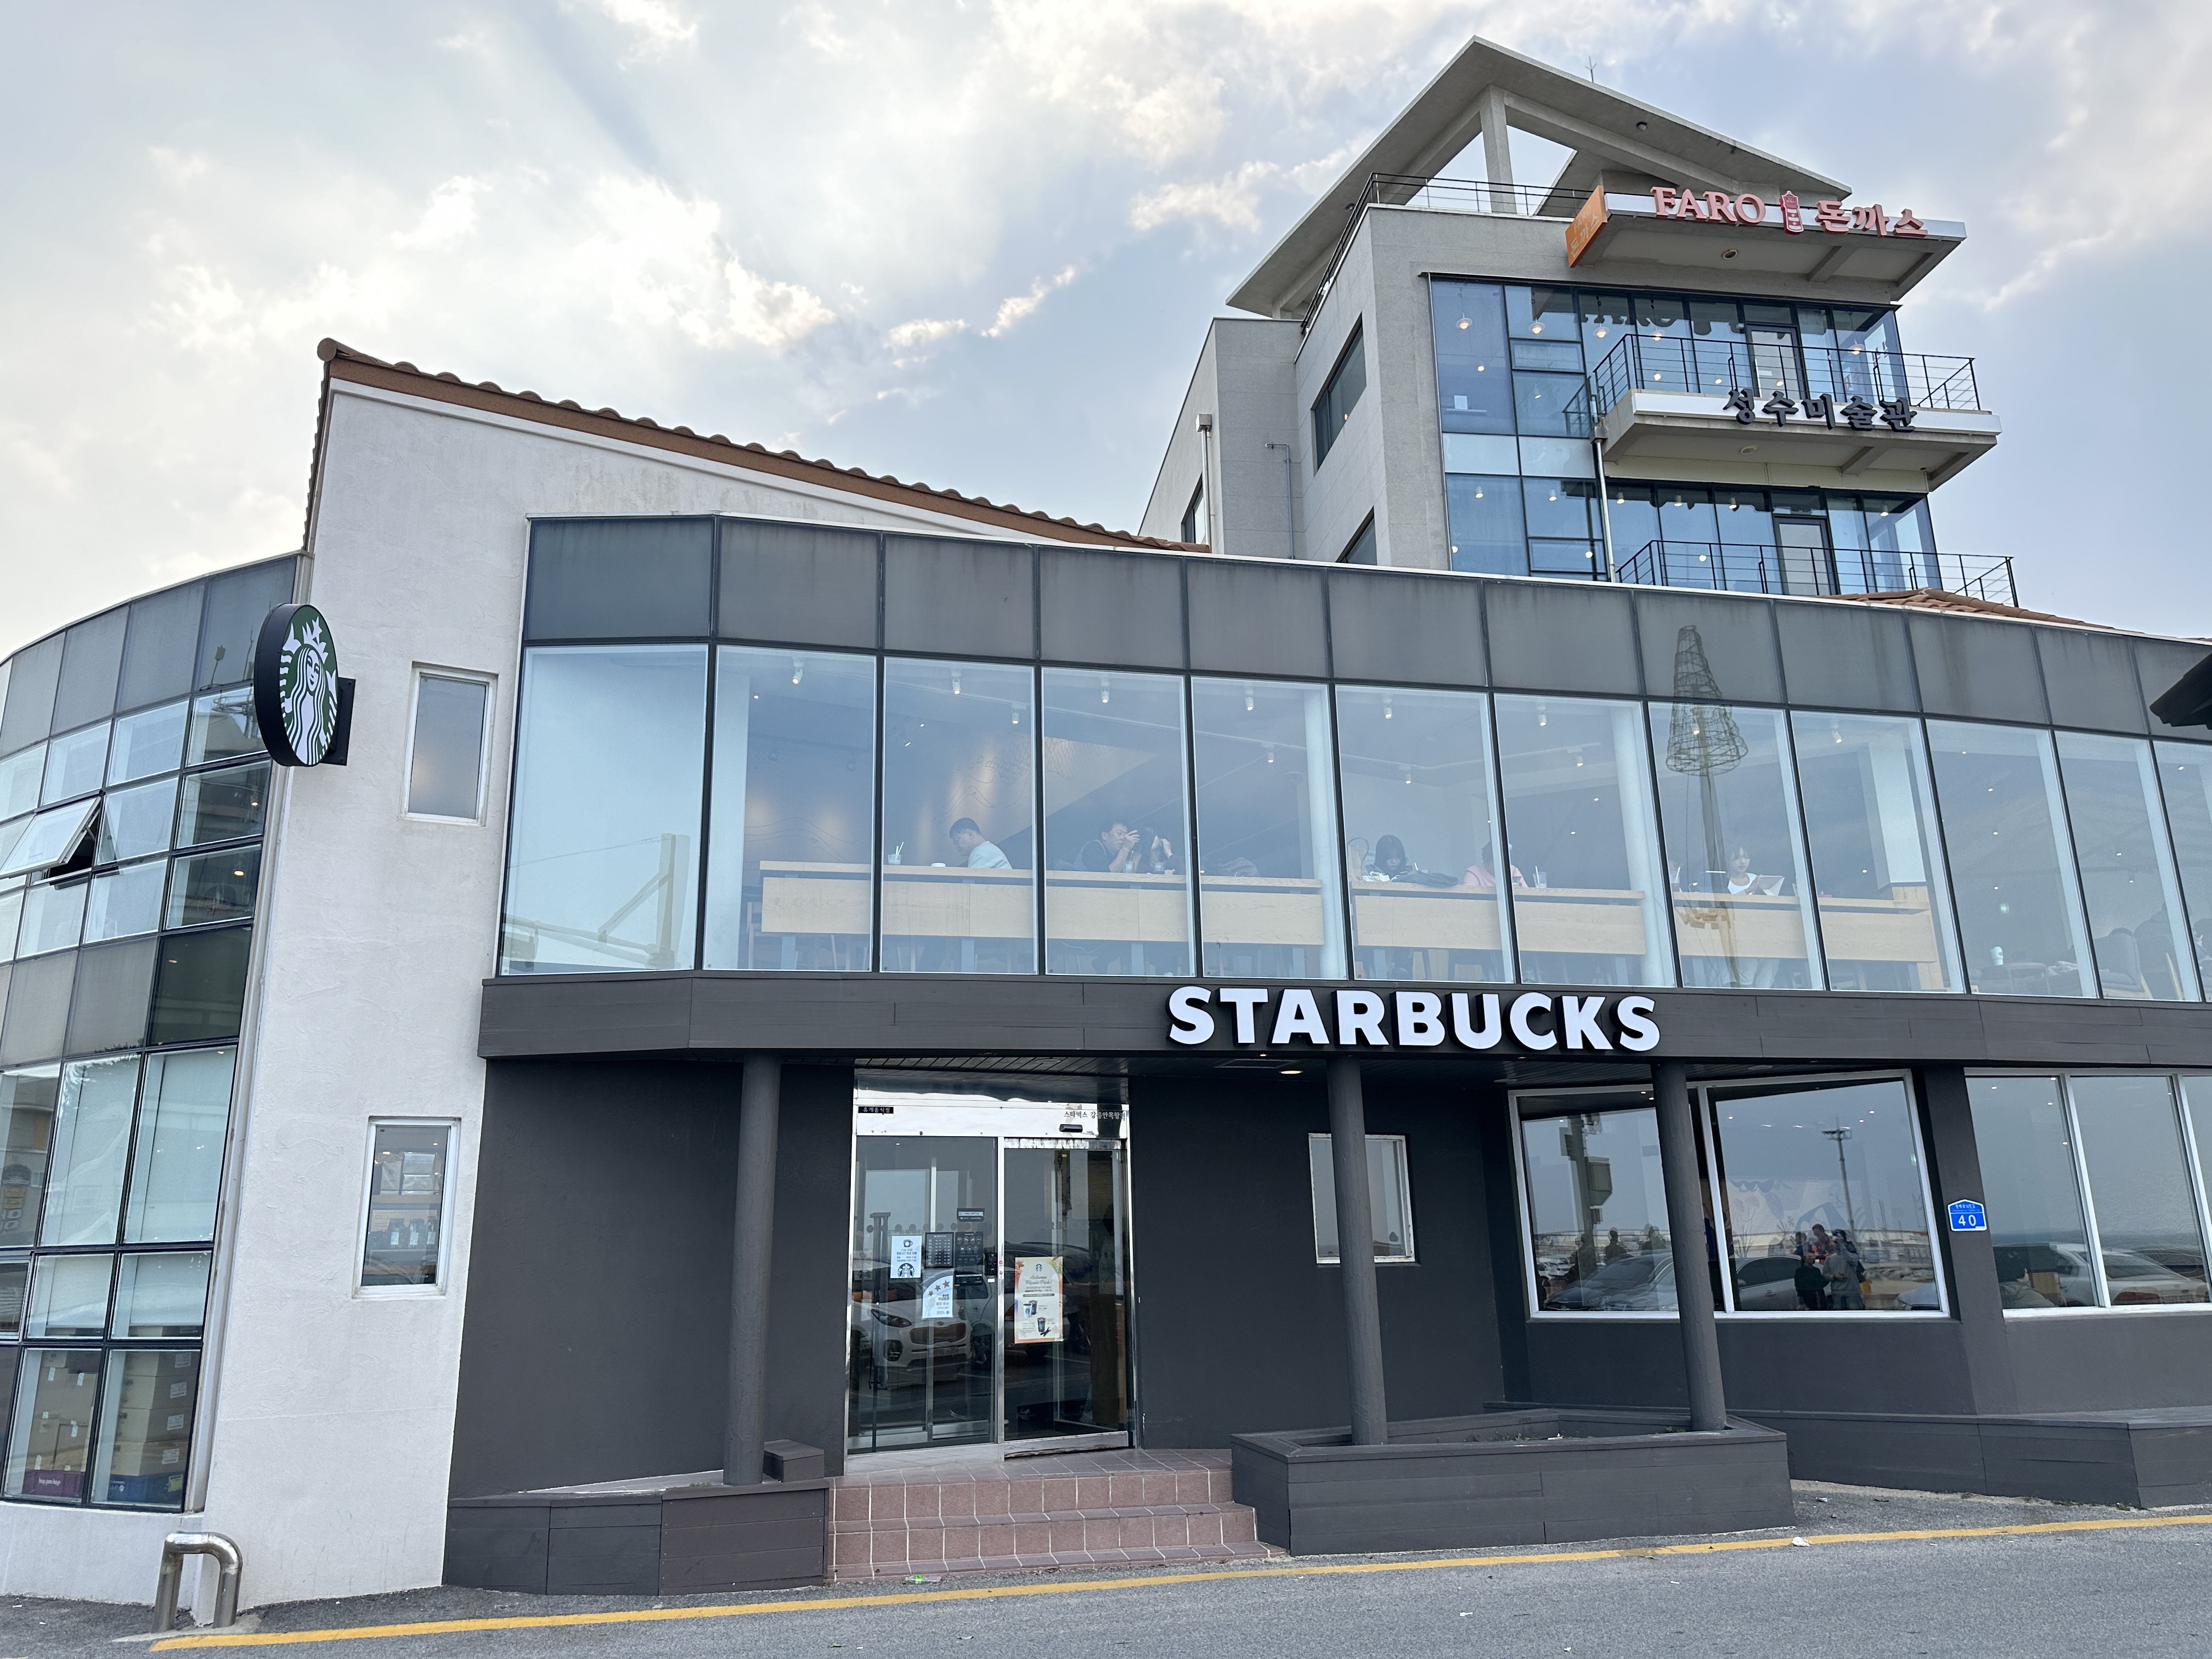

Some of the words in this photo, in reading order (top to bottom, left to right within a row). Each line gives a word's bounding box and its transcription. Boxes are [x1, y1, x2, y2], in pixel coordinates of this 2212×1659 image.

[1573, 204, 1591, 234] FARO
[1650, 186, 1766, 224] FARO
[1816, 200, 1928, 238] 돈까스
[1570, 213, 1599, 258] 돈까스
[1723, 388, 1918, 433] 성수미술관
[1166, 985, 1661, 1052] STARBUCKS
[1958, 1215, 1976, 1226] 40
